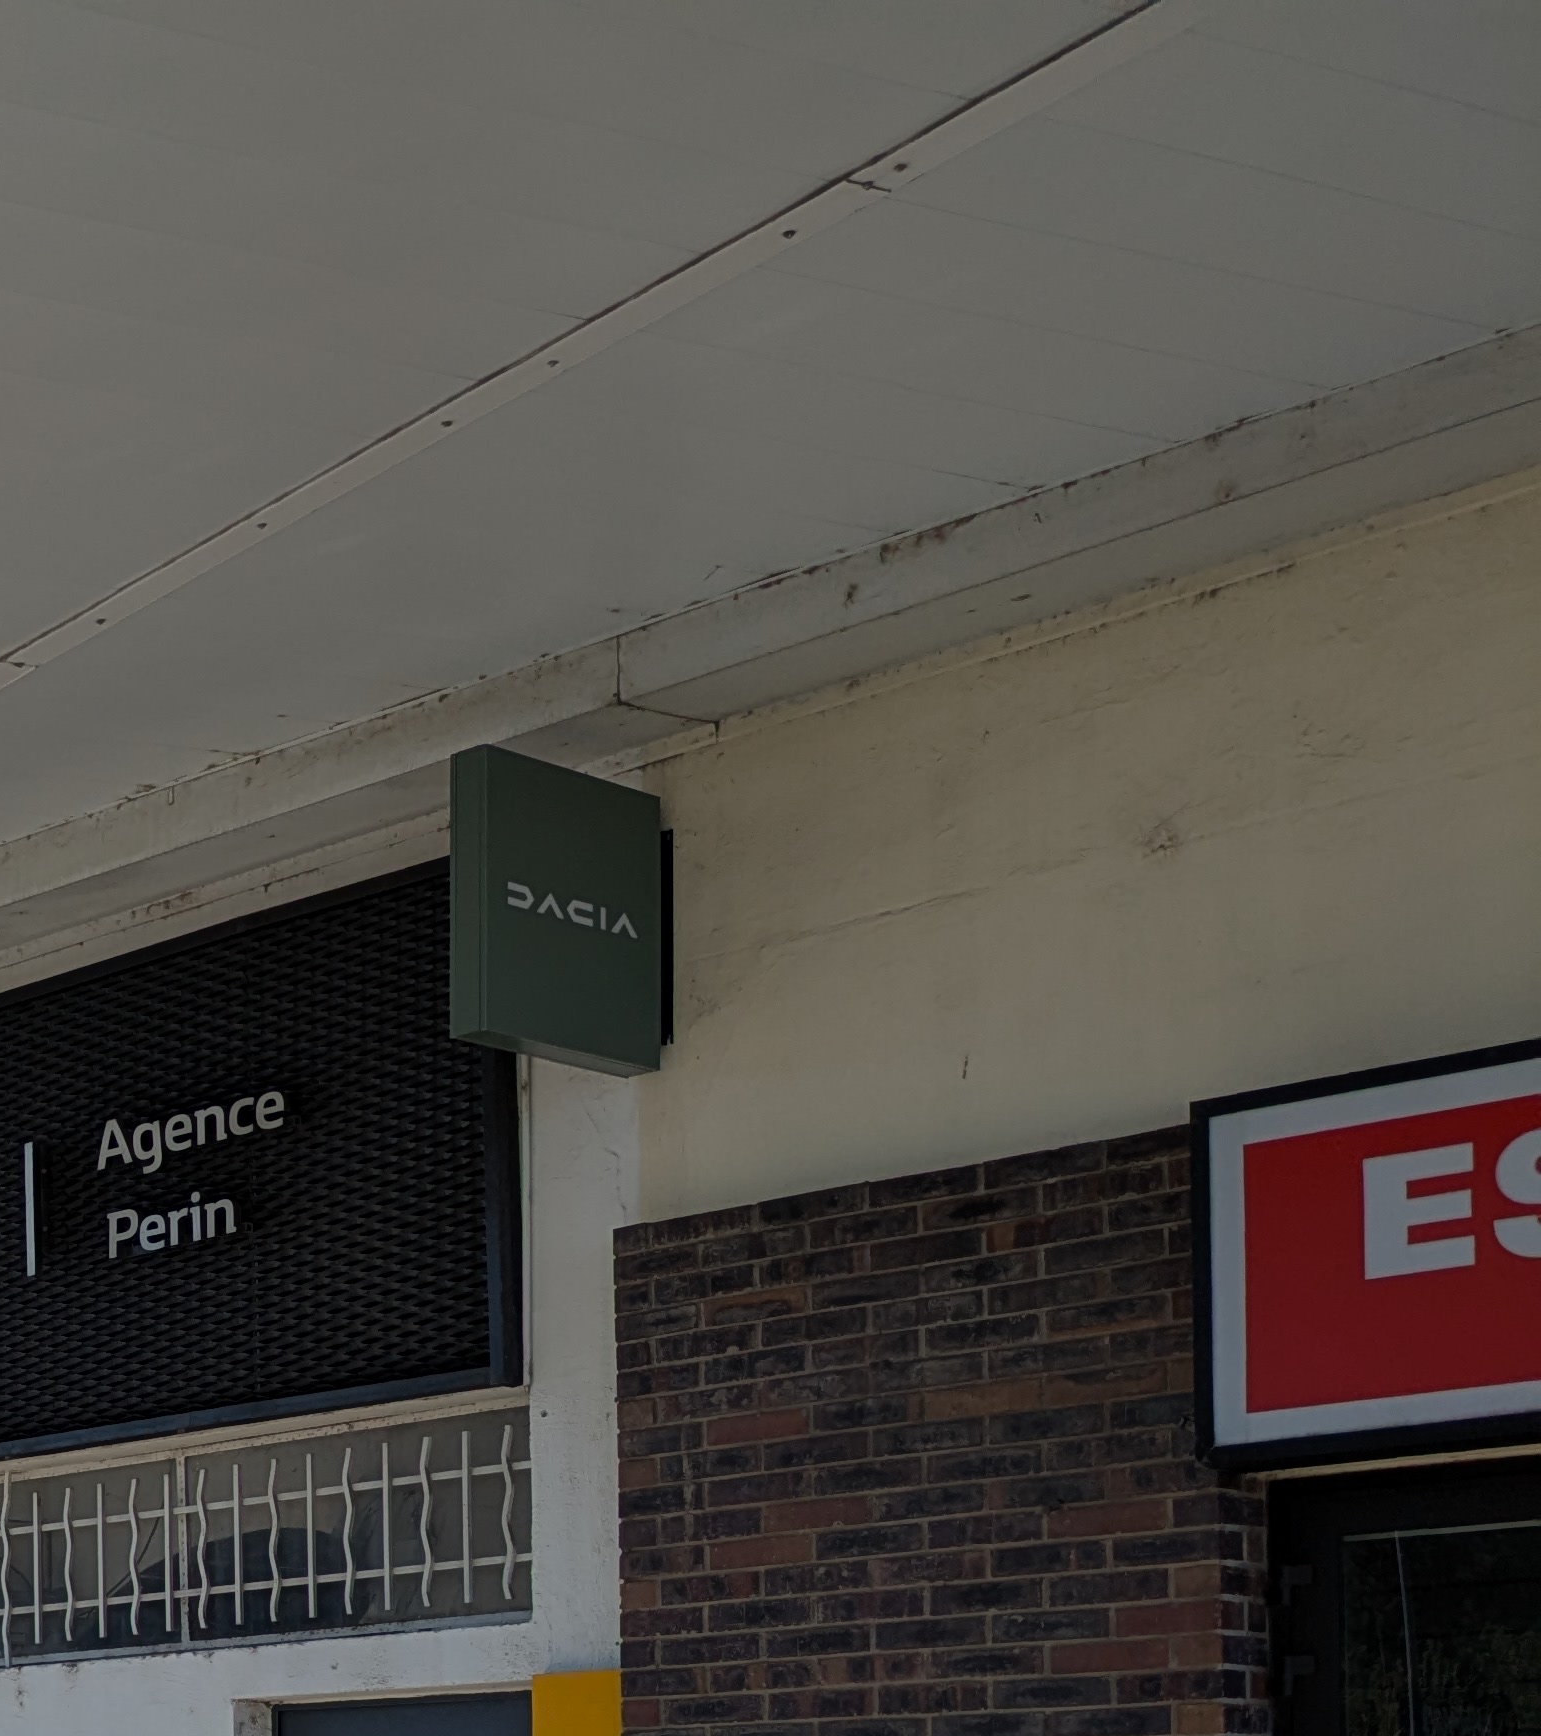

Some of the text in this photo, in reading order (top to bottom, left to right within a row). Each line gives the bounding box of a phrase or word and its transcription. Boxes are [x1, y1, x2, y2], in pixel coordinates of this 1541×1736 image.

[506, 881, 639, 940] DACIA
[96, 1090, 287, 1176] Agence
[106, 1191, 237, 1259] Perin
